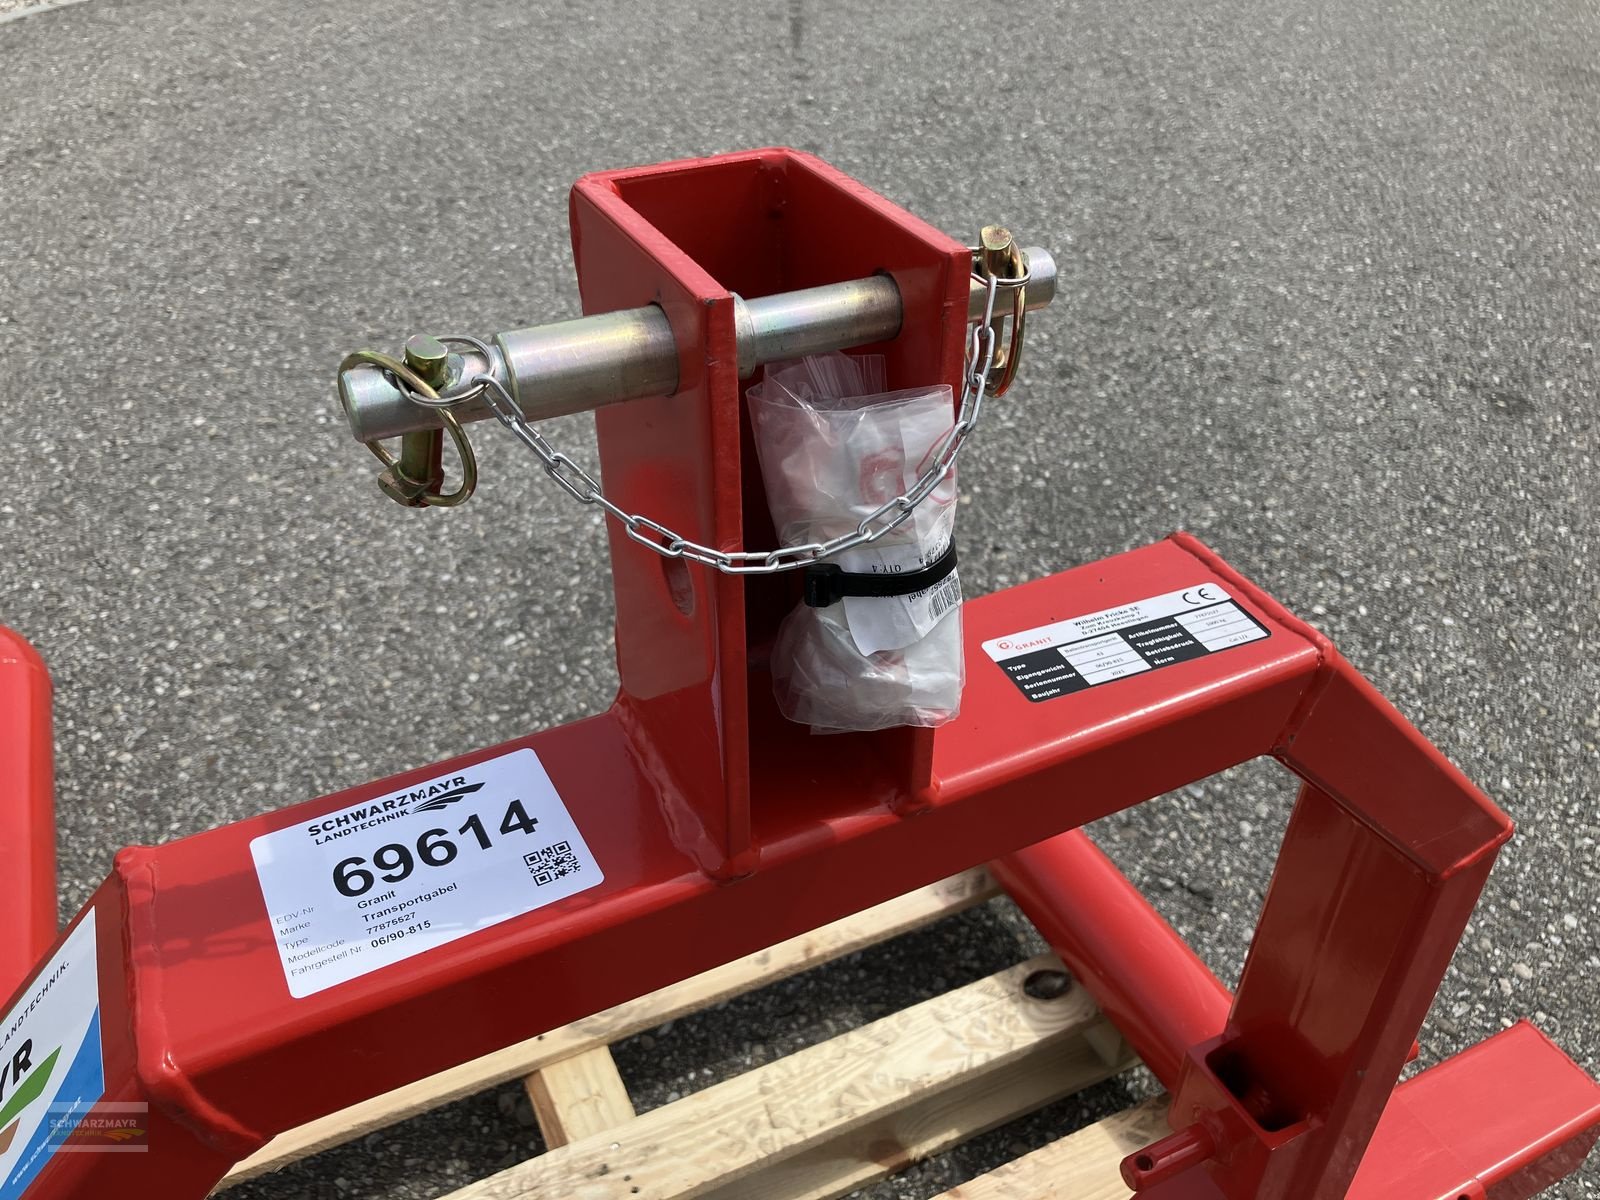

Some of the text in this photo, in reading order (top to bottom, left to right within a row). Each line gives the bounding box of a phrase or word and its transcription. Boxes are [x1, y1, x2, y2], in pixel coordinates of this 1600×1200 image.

[1073, 615, 1104, 627] Wilhelm
[1105, 609, 1128, 619] Fricke
[1081, 622, 1097, 630] Zum
[1128, 622, 1178, 640] Artikelnummer
[1136, 632, 1183, 648] Tragfähigkeit
[1015, 637, 1053, 650] GRANIT
[1145, 640, 1194, 656] Betriebsdruck
[1007, 663, 1026, 673] Type
[1154, 656, 1175, 665] Norm
[1016, 664, 1065, 681] Eigengewicht
[1024, 672, 1076, 690] Seriennummer
[1031, 688, 1060, 699] Baujahr
[307, 775, 467, 837] SCHWARZMAYR
[314, 808, 410, 846] LANDTECHNIK
[332, 798, 539, 898] 69614
[280, 890, 397, 937] Marke Granit
[284, 882, 458, 951] Type Transportgabel
[287, 911, 416, 964] Modellcode 77875527
[291, 950, 348, 977] Fahrgestell
[370, 919, 431, 949] 06/90-815
